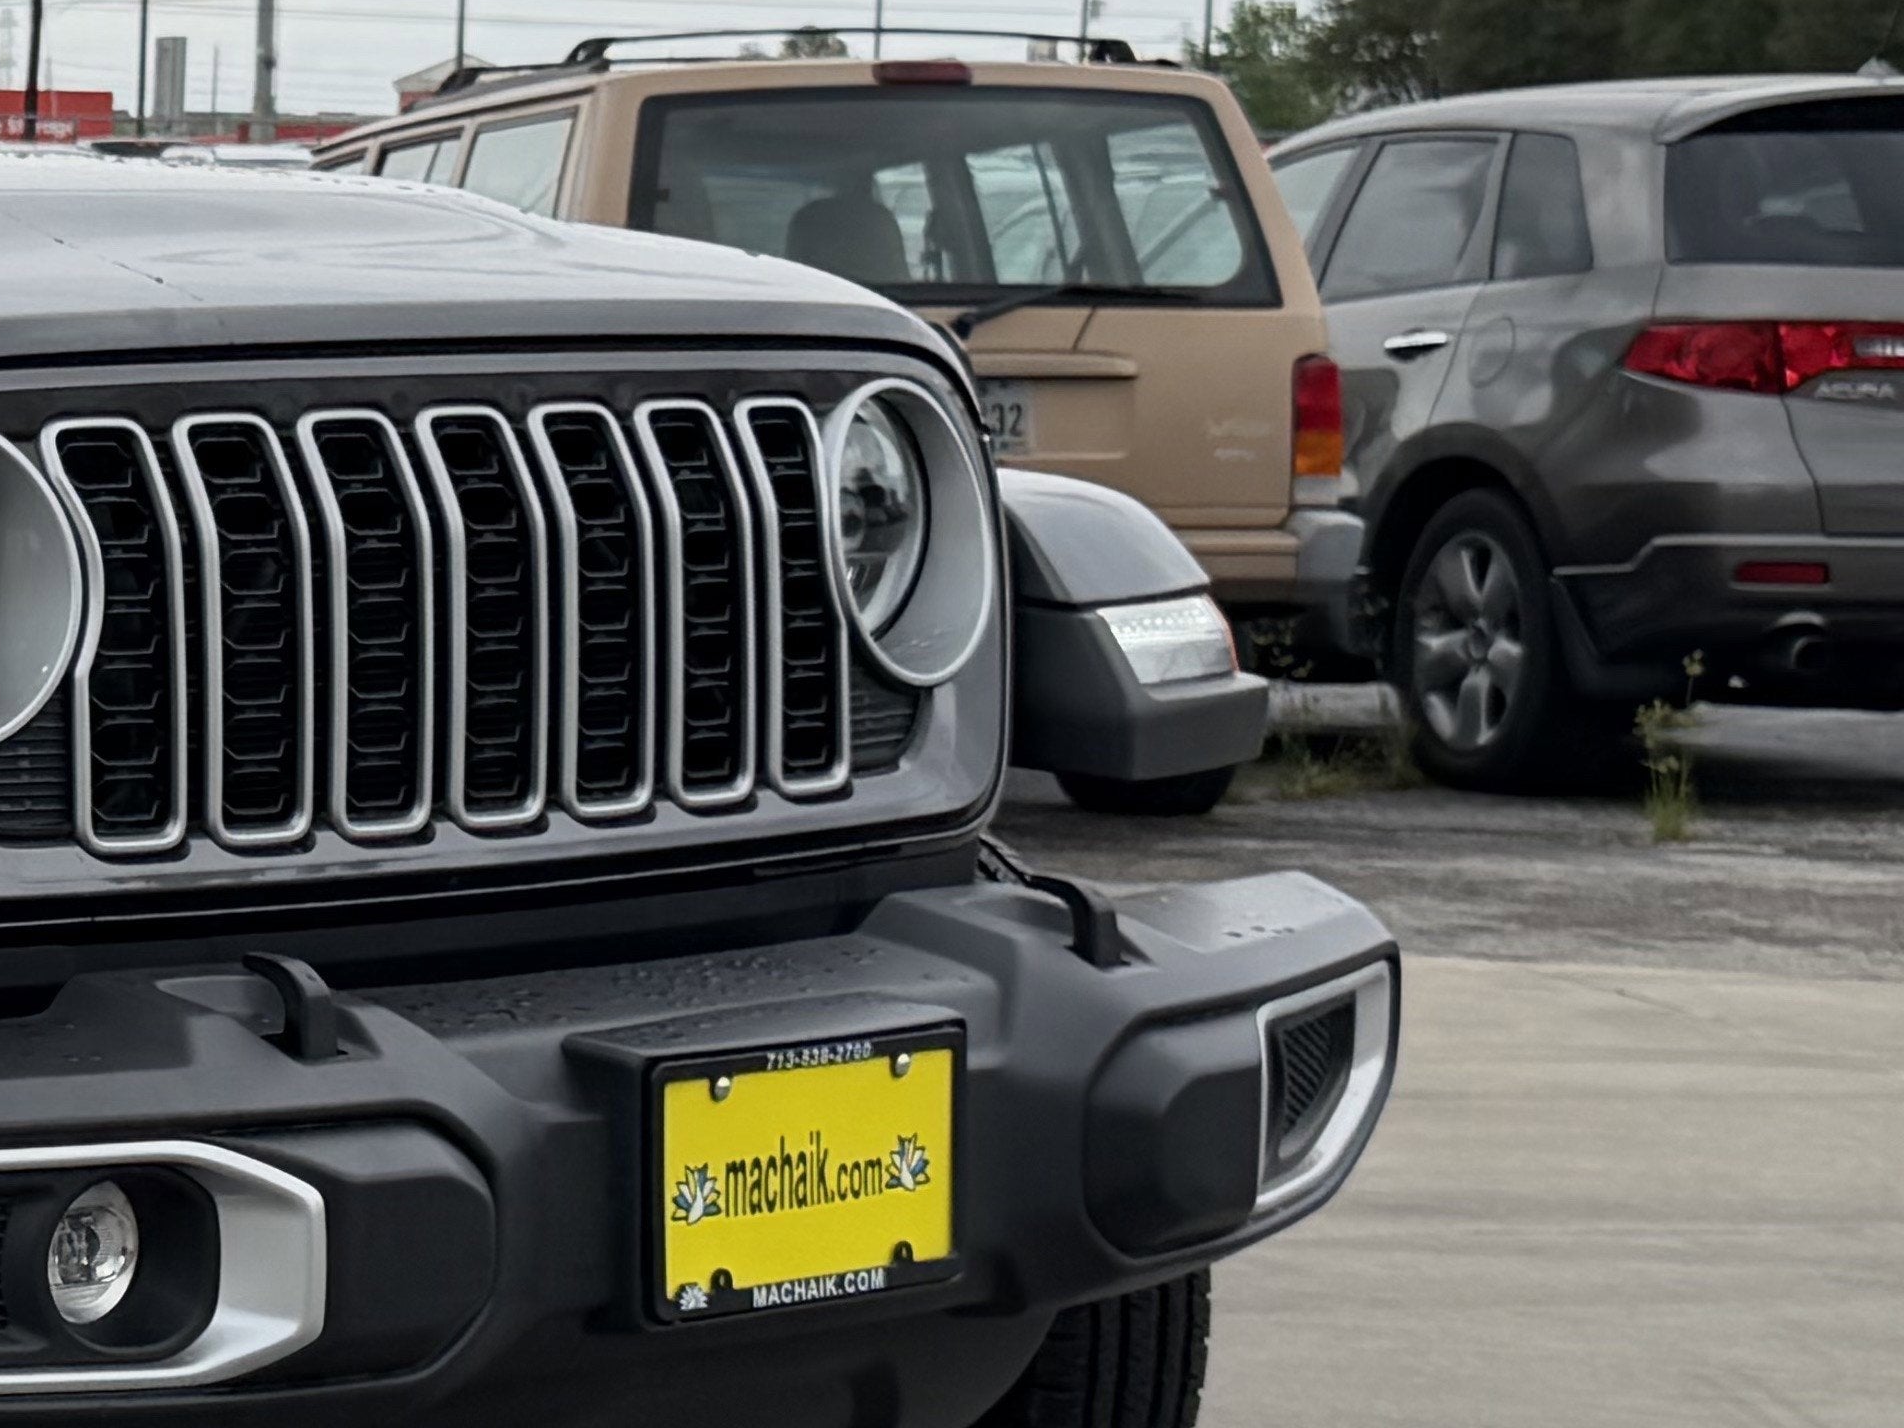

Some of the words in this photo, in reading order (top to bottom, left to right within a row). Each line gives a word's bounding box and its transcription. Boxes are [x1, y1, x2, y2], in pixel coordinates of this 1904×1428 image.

[1813, 382, 1896, 400] ACURA
[724, 1129, 885, 1218] machaik.com
[751, 1266, 885, 1309] MACHAIK.COM
